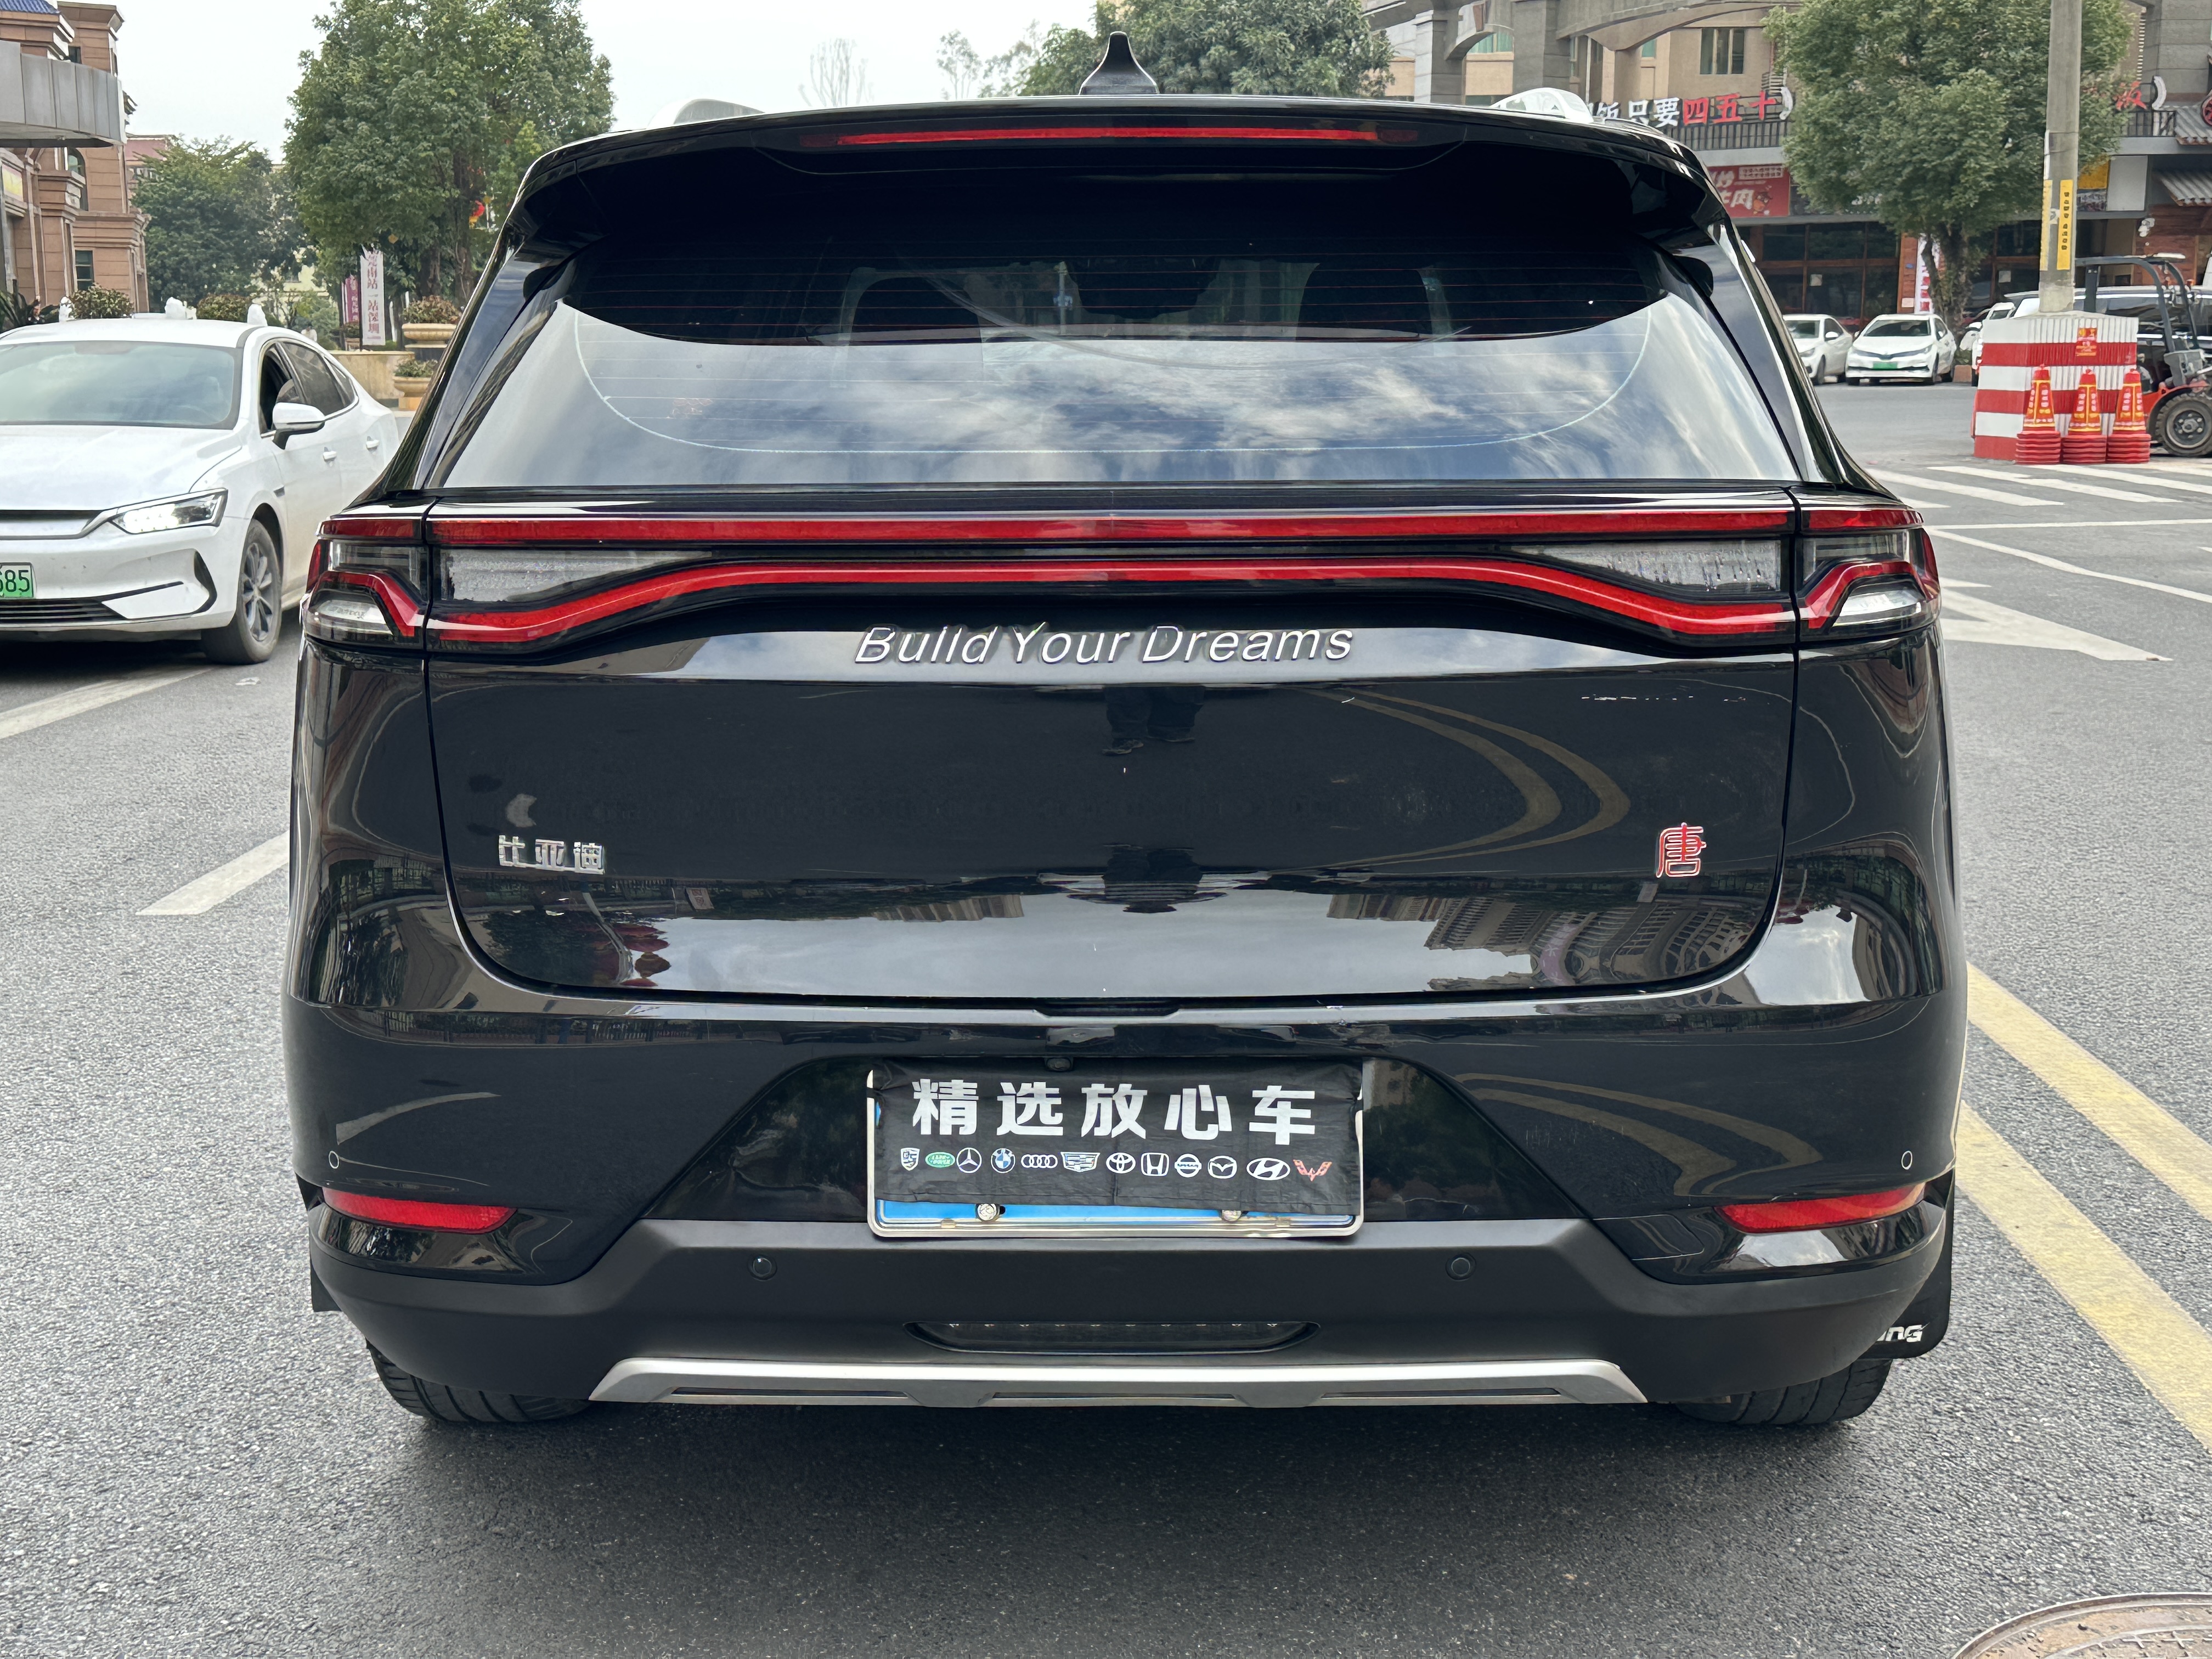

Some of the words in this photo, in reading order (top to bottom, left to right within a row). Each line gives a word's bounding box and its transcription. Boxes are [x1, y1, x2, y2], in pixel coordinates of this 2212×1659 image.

[855, 626, 998, 663] Build
[1012, 621, 1131, 664] Your
[1142, 625, 1353, 662] Dreams
[499, 835, 605, 875] 比亚迪
[1656, 822, 1707, 878] 唐
[912, 1079, 1316, 1146] 精选放心车
